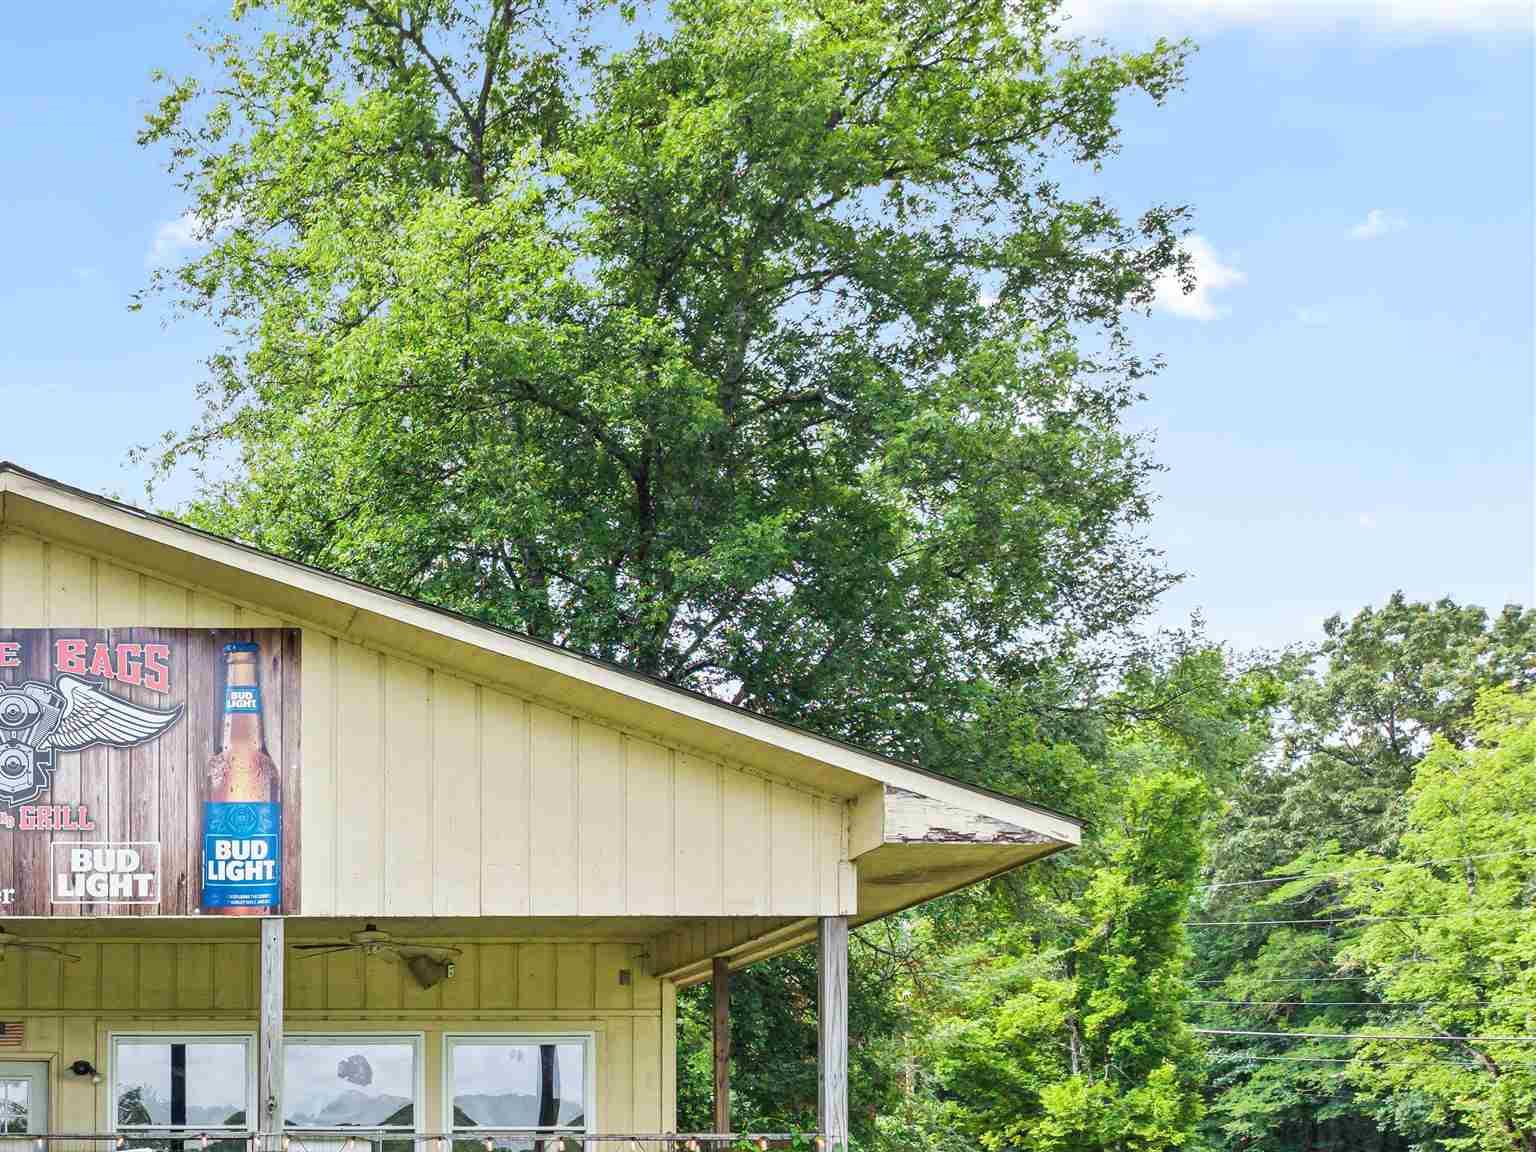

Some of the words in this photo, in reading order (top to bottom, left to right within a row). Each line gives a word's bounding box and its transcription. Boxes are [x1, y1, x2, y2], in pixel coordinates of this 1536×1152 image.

[56, 639, 170, 694] BAGS
[230, 691, 254, 700] BUD
[19, 805, 95, 831] GRILL
[71, 848, 140, 873] BUD
[215, 840, 268, 860] BUD
[208, 860, 275, 881] LIGHT
[57, 873, 154, 898] LIGHT
